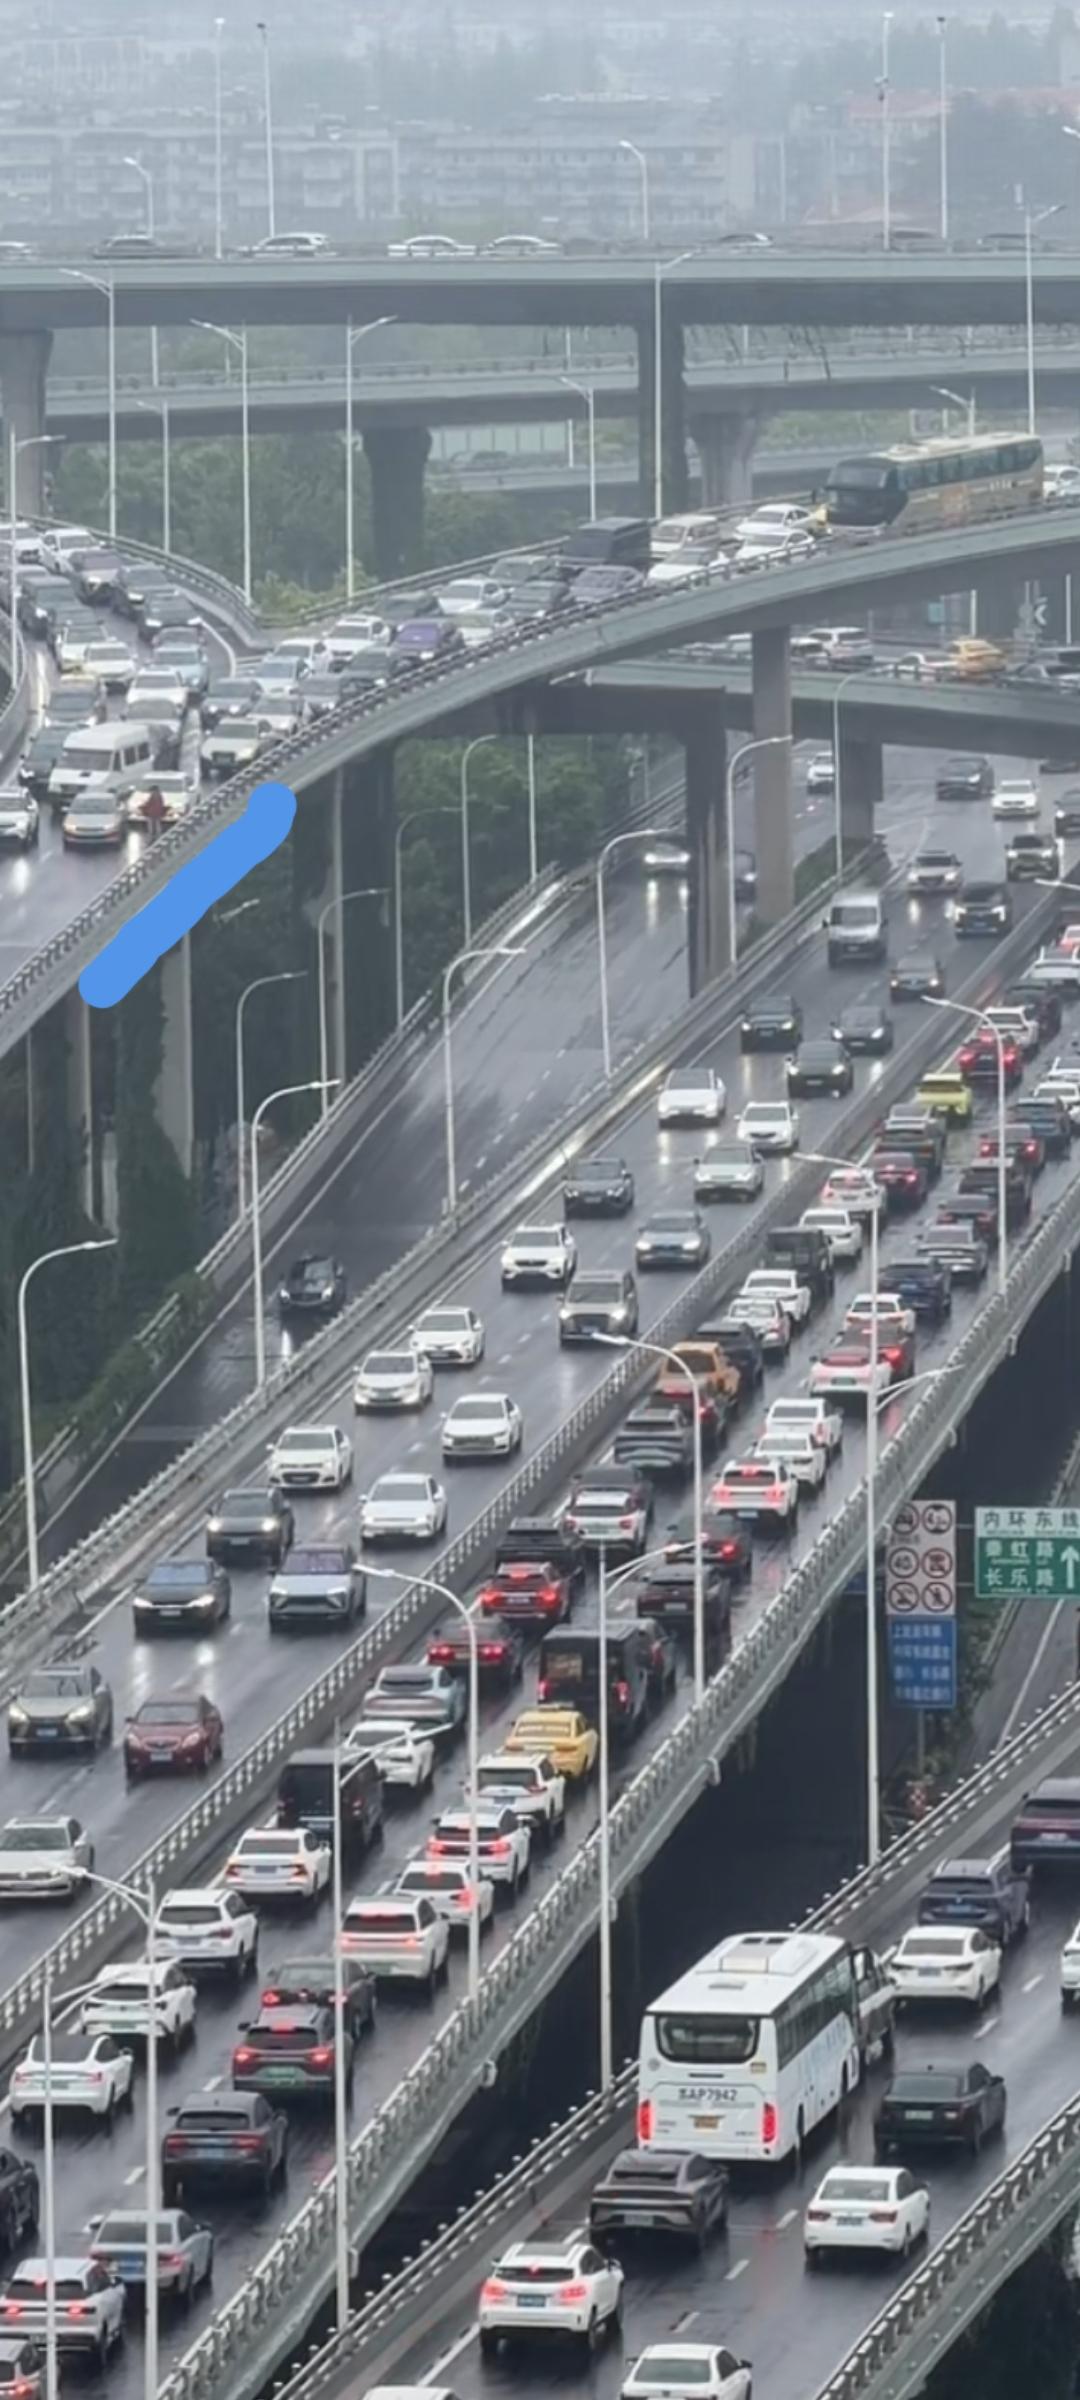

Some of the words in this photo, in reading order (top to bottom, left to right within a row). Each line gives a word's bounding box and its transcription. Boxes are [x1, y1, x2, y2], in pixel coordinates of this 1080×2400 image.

[984, 1510, 1079, 1529] 内环东线
[984, 1567, 1054, 1587] 长乐路
